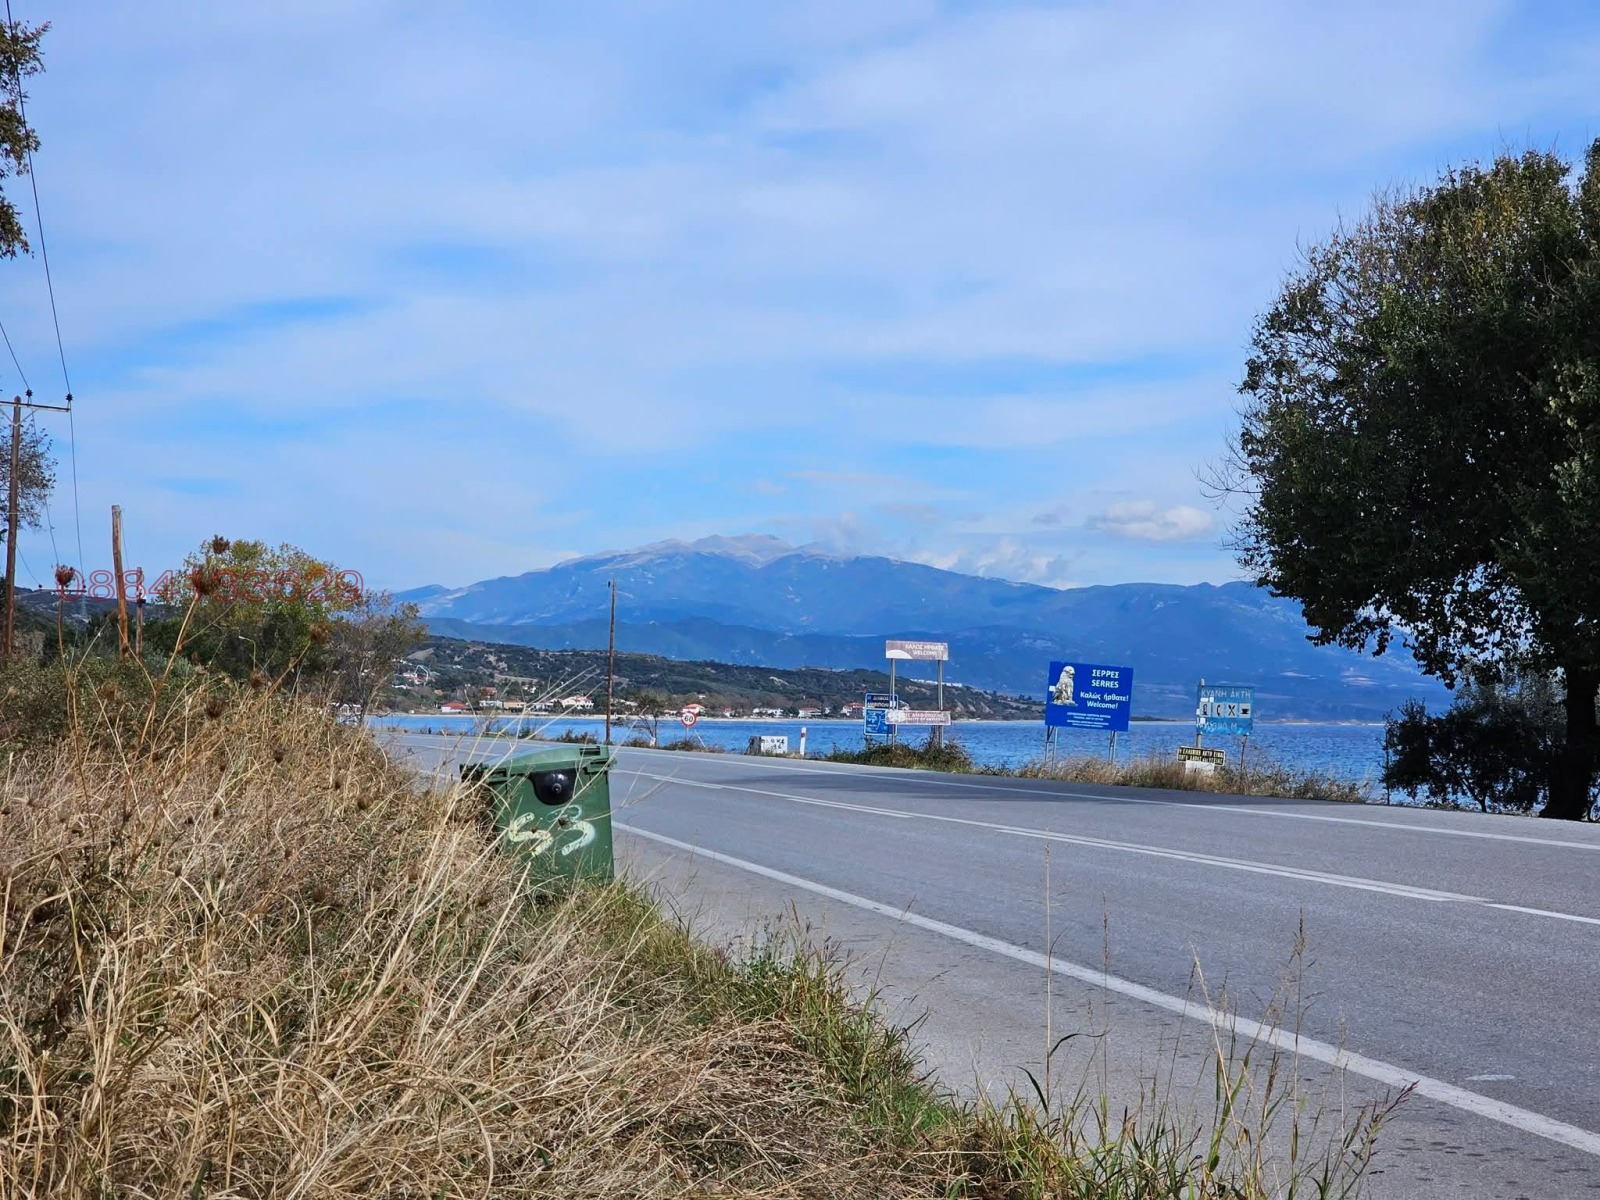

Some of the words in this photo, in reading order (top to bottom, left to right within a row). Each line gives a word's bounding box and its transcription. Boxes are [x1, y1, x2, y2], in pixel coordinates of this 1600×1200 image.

[1092, 669, 1119, 679] ΣΕΡΡΕΣ
[1091, 679, 1119, 688] SERRES
[1080, 691, 1101, 701] Καλώς
[1103, 692, 1129, 702] ήρθατε!
[1086, 700, 1119, 710] Welcome!
